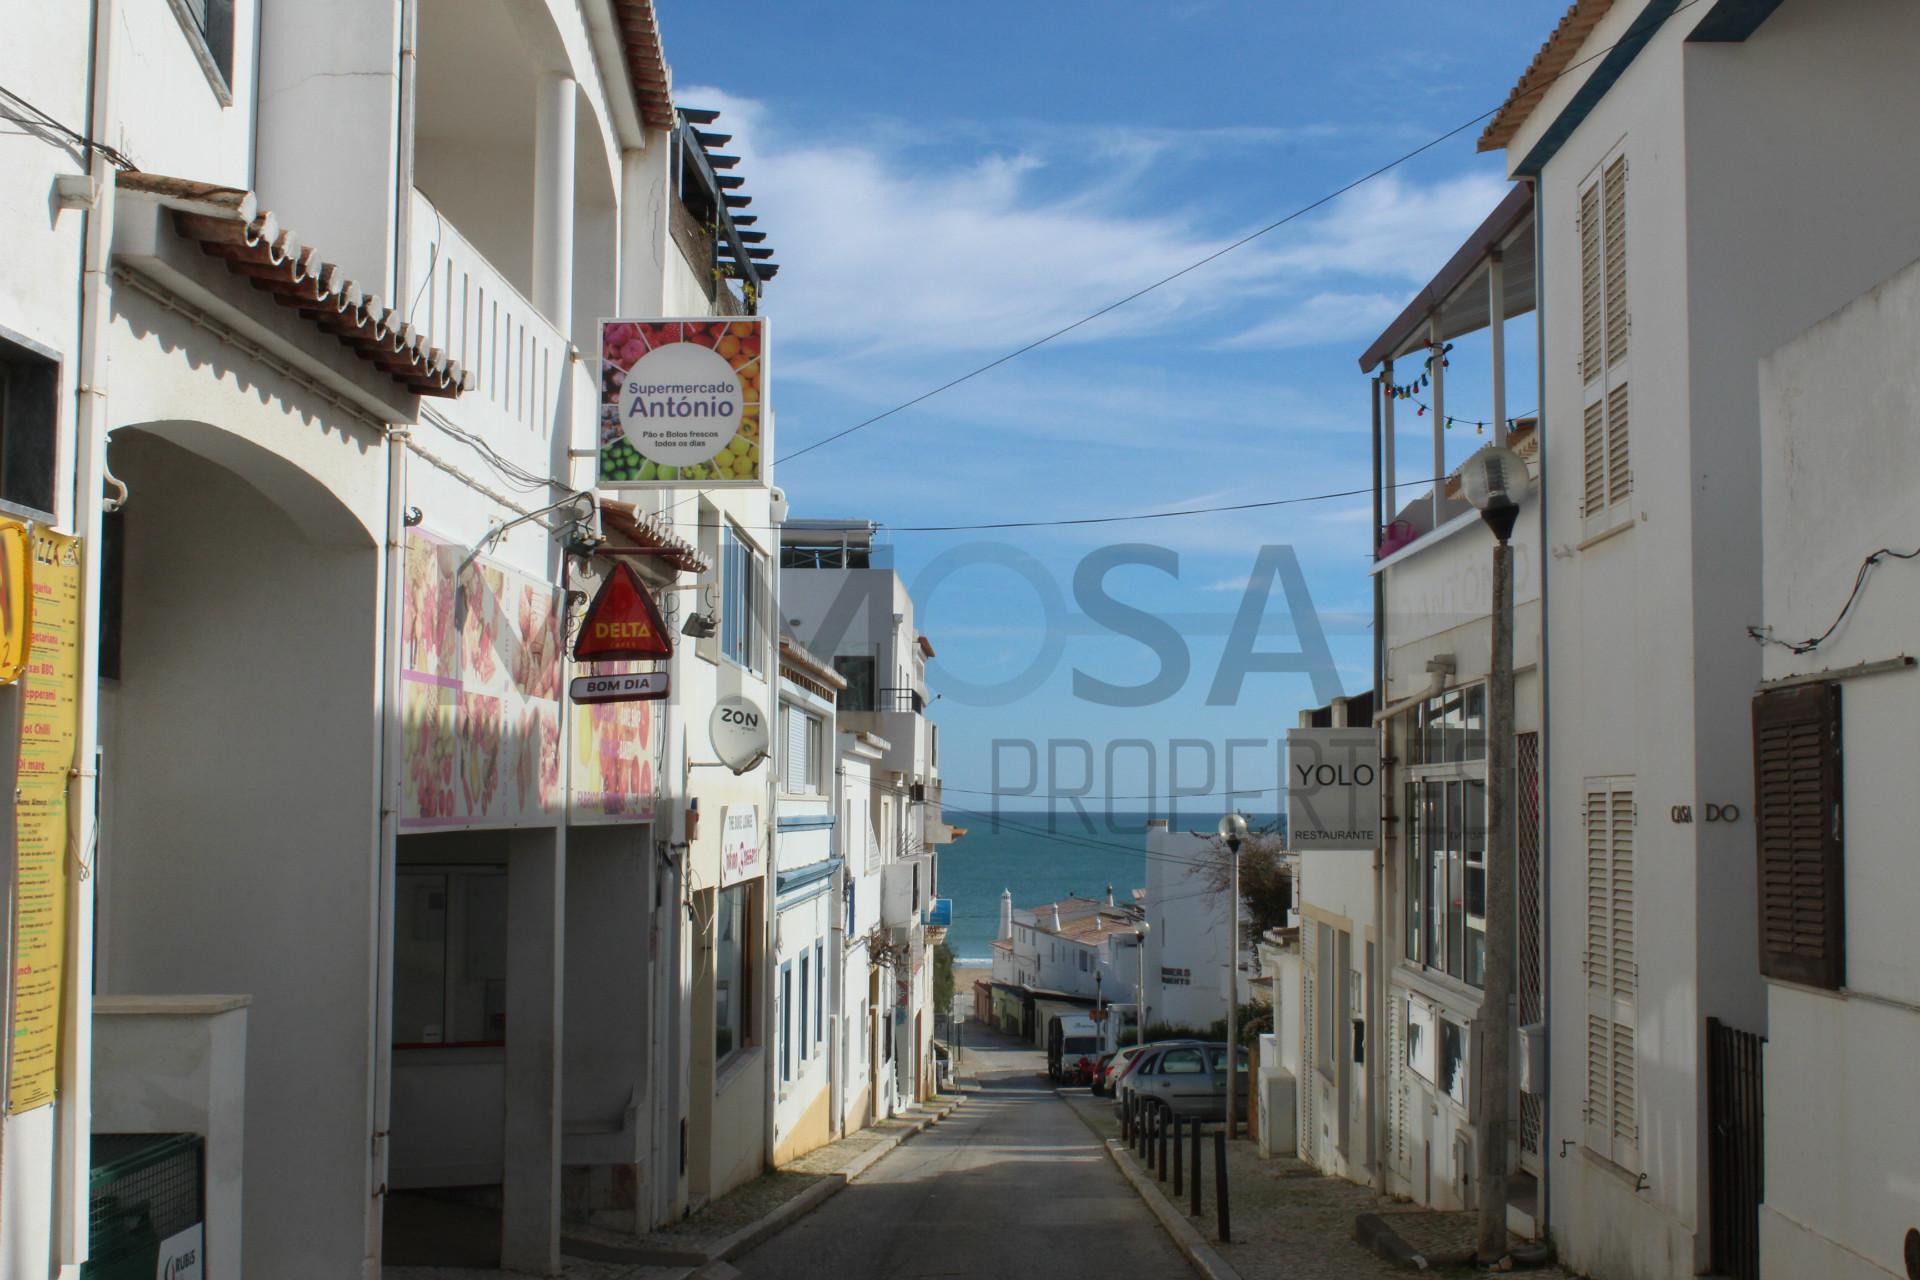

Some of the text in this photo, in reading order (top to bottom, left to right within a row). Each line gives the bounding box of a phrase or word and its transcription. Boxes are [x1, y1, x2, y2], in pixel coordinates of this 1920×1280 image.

[628, 381, 734, 397] Supermercado
[628, 396, 734, 418] António
[642, 430, 658, 438] Pão
[666, 430, 688, 438] Bolos
[689, 430, 719, 438] frescos
[655, 440, 676, 448] todos
[689, 440, 706, 448] dias
[595, 622, 651, 639] DELTA
[586, 678, 650, 693] BOM DIA
[721, 708, 759, 727] ZON
[1295, 763, 1375, 787] YOLO
[1671, 803, 1740, 824] CASA DO
[1294, 830, 1375, 841] RESTAURANTE
